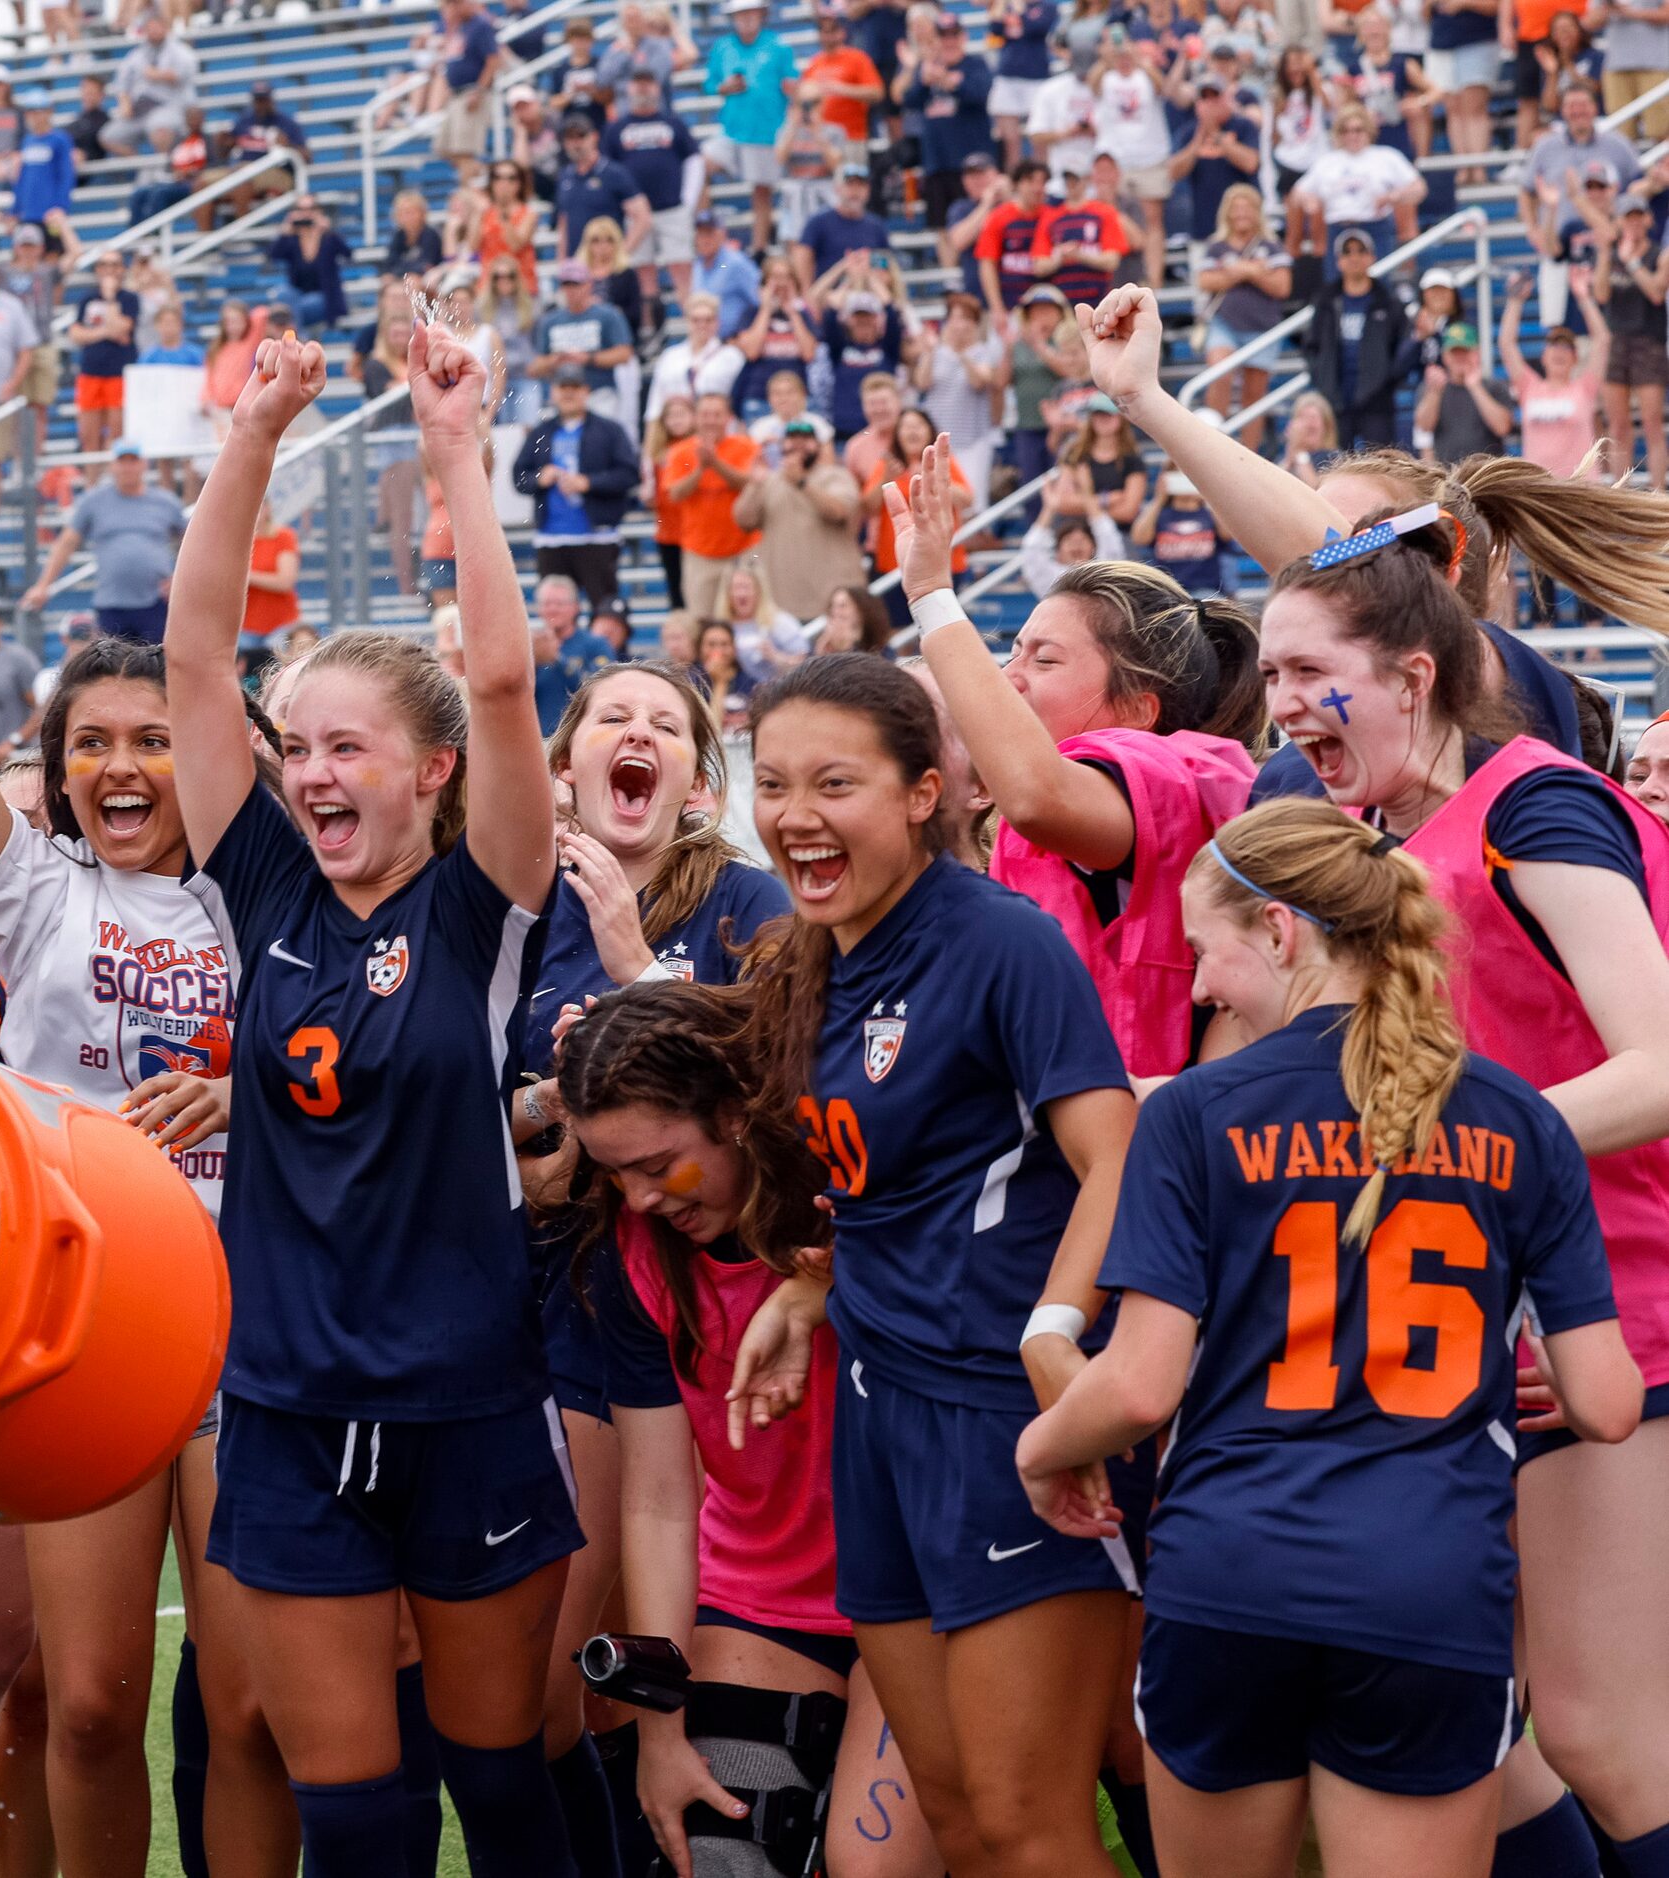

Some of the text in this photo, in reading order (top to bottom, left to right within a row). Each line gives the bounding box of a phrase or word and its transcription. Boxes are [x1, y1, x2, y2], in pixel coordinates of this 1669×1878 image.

[80, 1044, 109, 1070] 20
[127, 1010, 226, 1043] WOLVERINES
[287, 1026, 342, 1117] 3
[1227, 1121, 1516, 1192] WAKAND
[1264, 1199, 1489, 1419] 16
